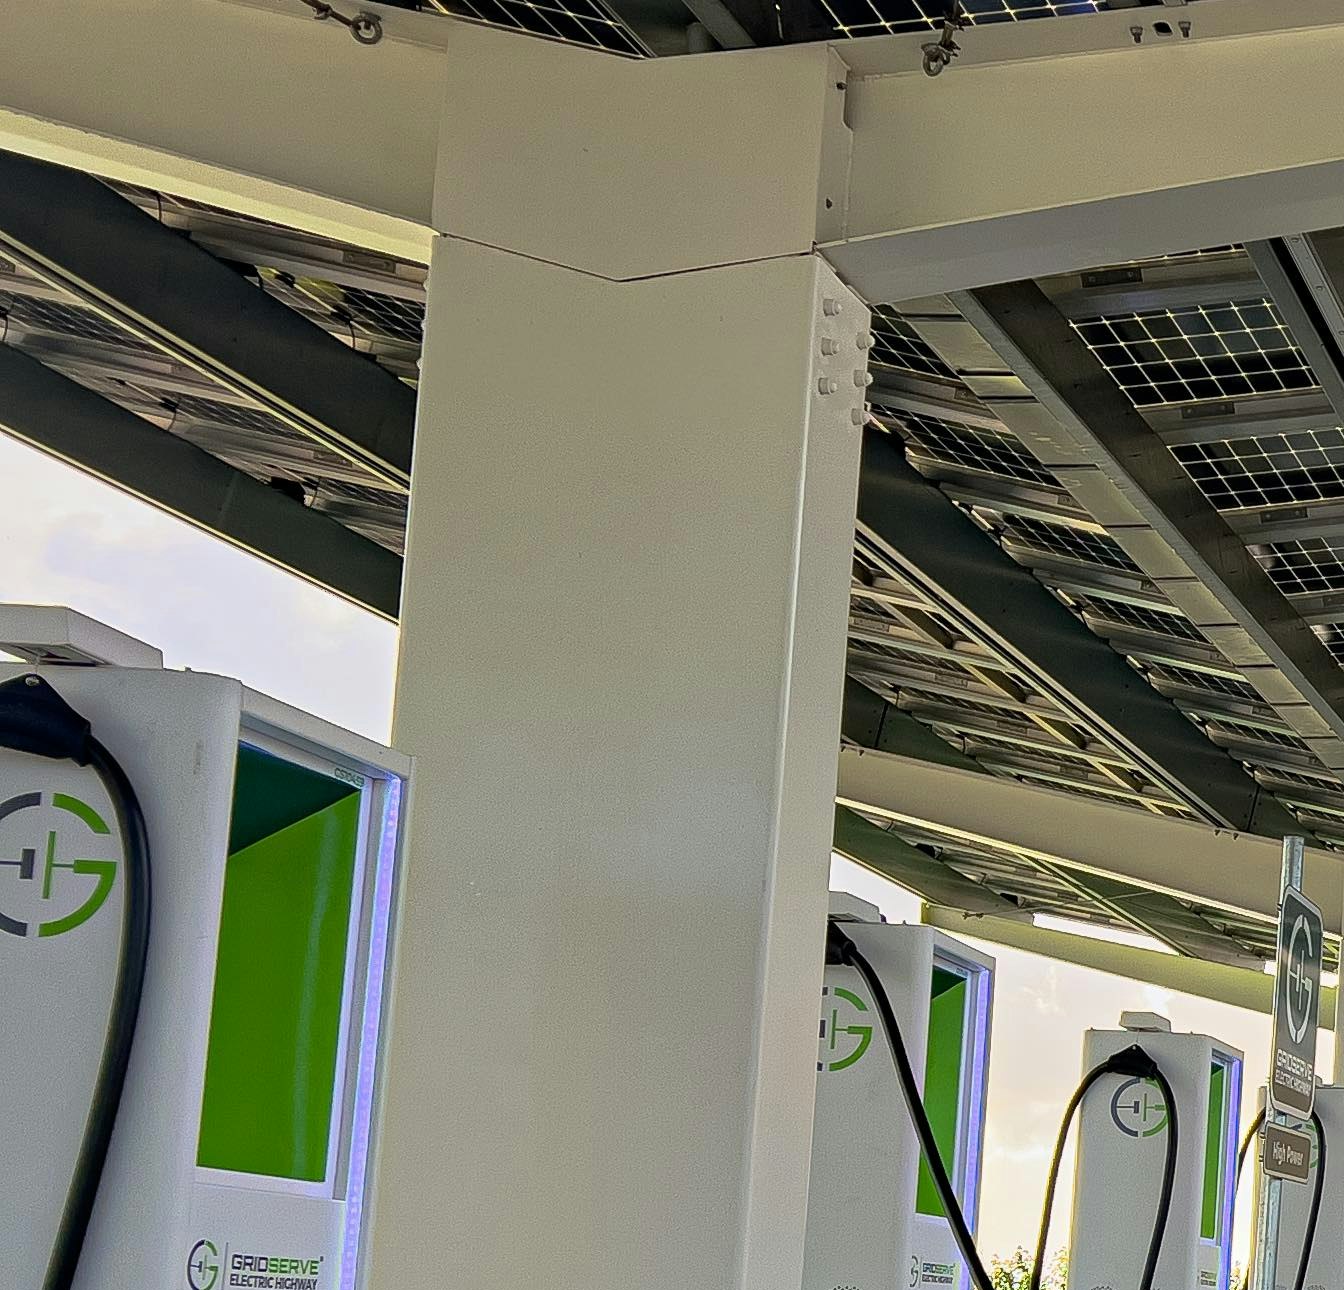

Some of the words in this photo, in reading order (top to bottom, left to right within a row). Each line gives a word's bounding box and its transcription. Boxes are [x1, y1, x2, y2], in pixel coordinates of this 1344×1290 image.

[1272, 1141, 1286, 1166] High
[1286, 1145, 1304, 1166] Power
[231, 1254, 320, 1275] GRIDSERVE
[229, 1274, 274, 1289] ELECTRIC
[274, 1277, 318, 1290] HIGHWAY
